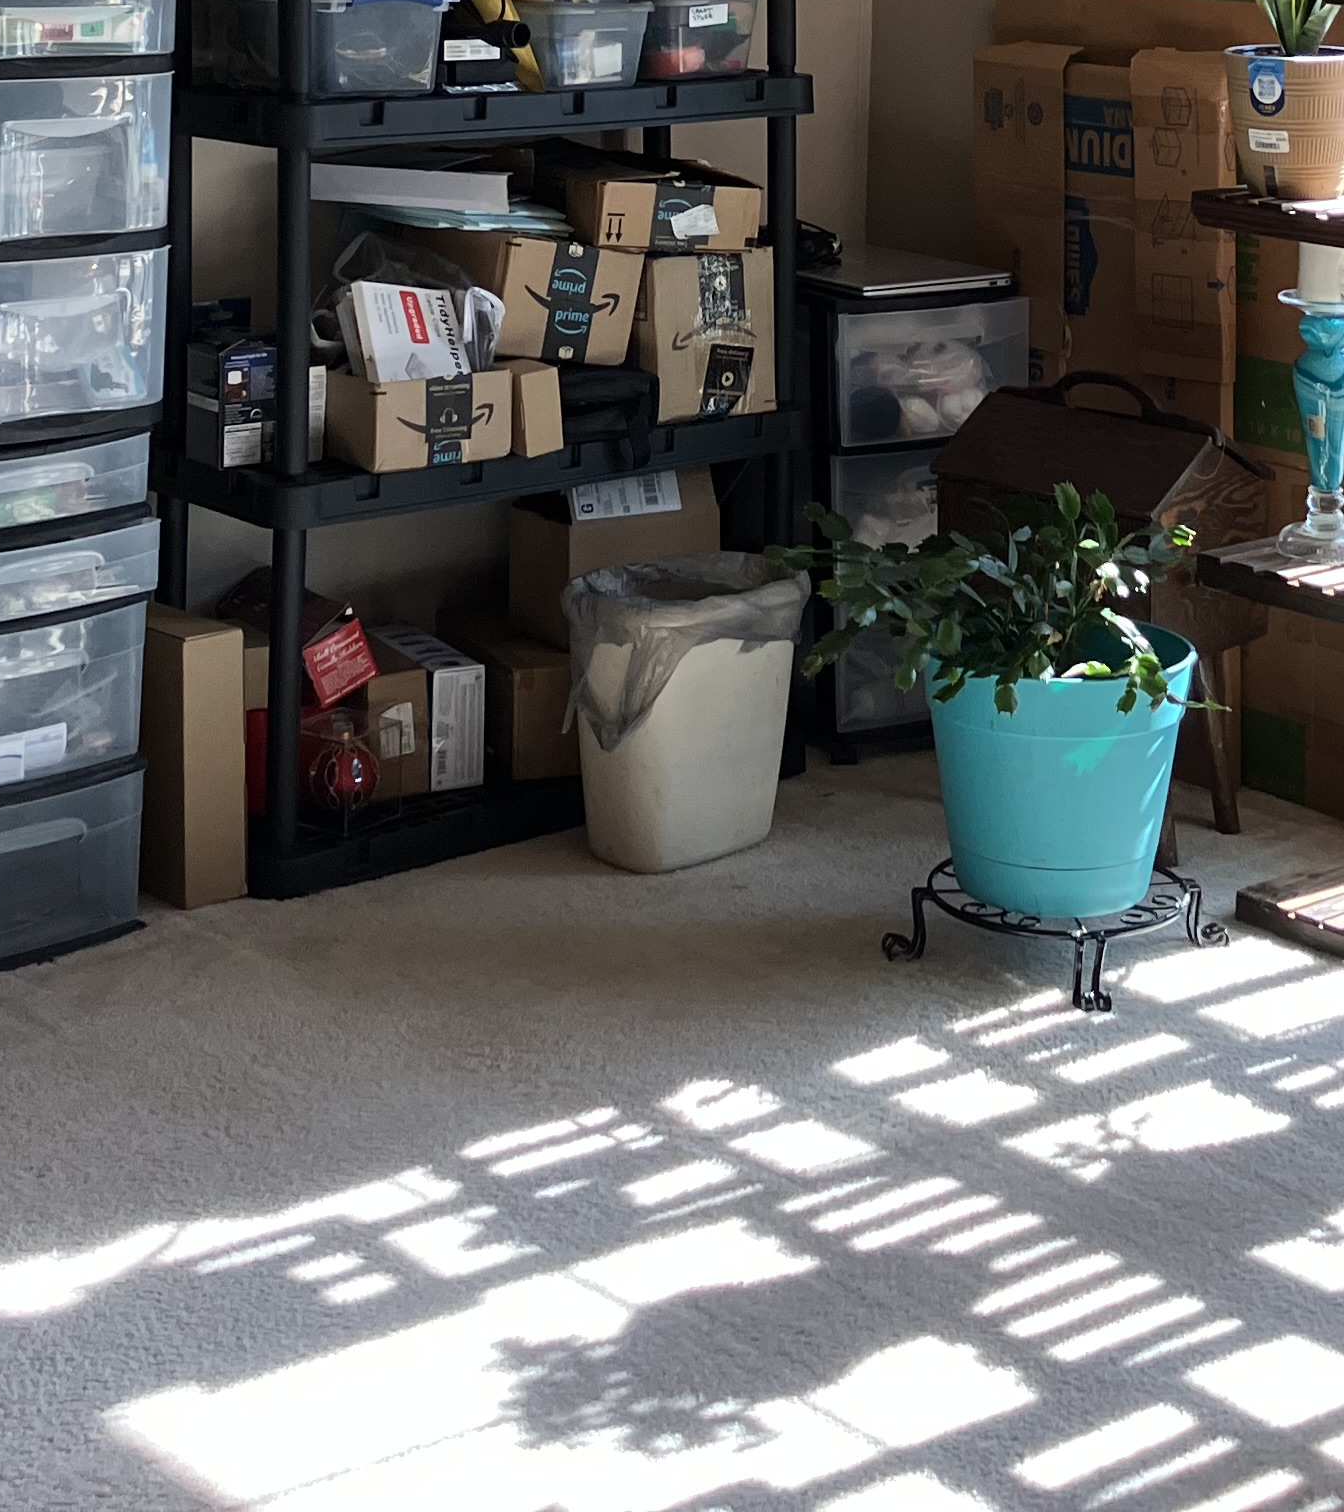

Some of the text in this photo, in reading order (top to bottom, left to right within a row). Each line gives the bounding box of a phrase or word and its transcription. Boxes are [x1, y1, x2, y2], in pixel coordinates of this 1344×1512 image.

[551, 279, 587, 296] prime
[406, 295, 424, 341] Upgraded
[555, 307, 590, 326] prime
[432, 449, 463, 464] rime
[581, 503, 594, 514] G
